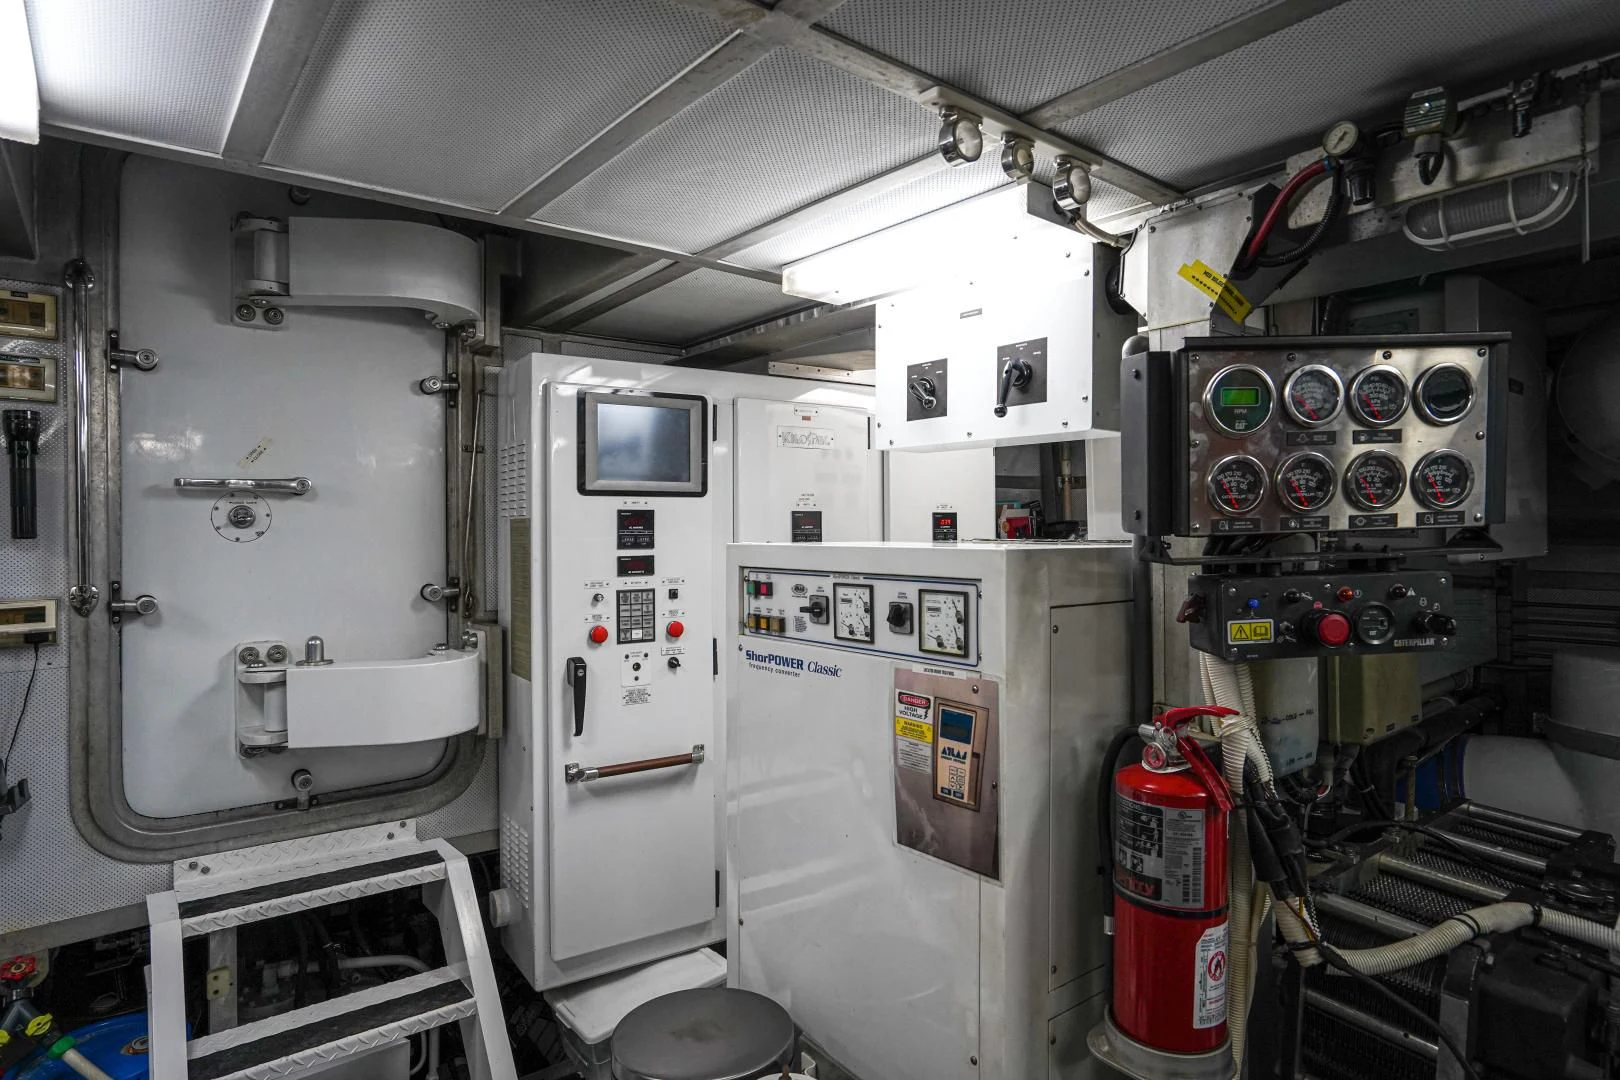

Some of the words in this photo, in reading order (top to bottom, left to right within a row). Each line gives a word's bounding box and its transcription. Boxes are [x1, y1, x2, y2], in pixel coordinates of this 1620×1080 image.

[1393, 638, 1435, 647] CATERPILLAR
[745, 649, 804, 671] ShorPOWER
[807, 660, 841, 678] Classic
[774, 667, 801, 678] converter
[903, 695, 926, 705] DANGER
[904, 705, 918, 713] HIGH
[899, 710, 923, 720] VOLTAGE
